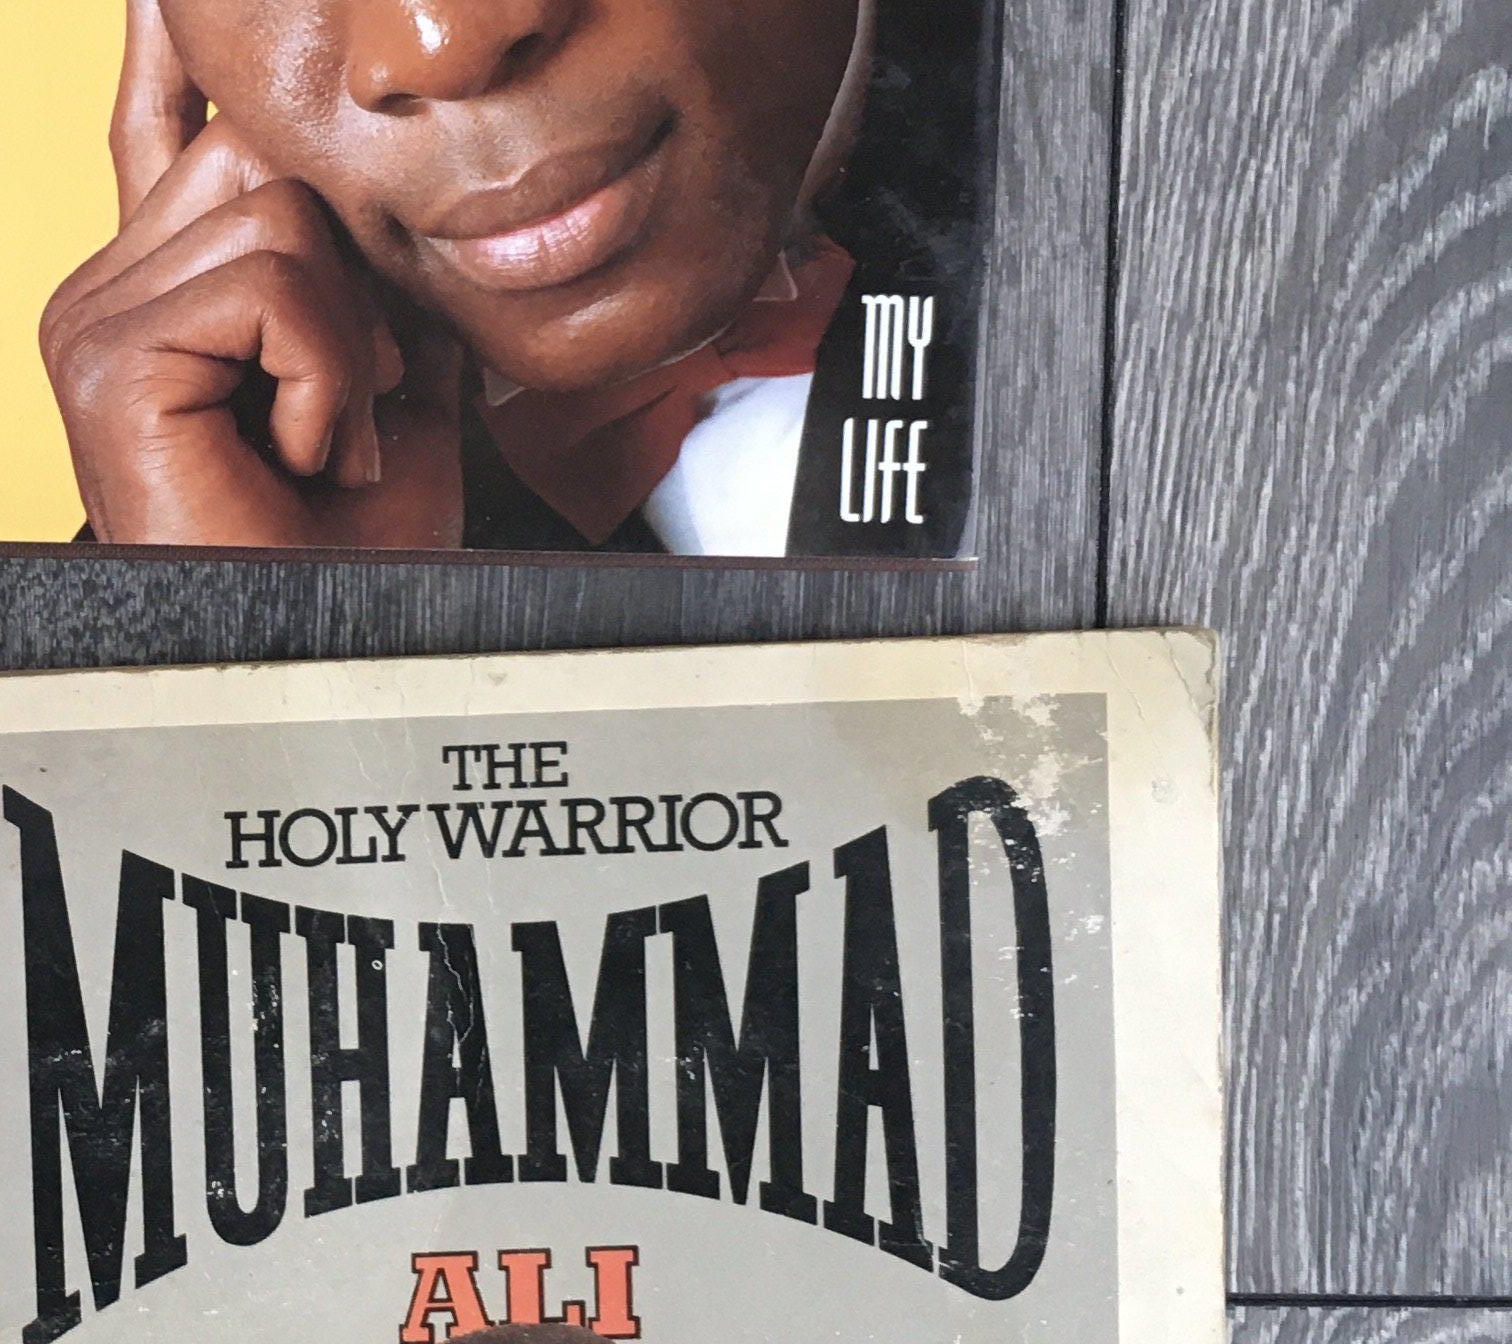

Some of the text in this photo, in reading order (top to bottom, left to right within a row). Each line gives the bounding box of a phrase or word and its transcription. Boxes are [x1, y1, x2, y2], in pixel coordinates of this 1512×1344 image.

[861, 294, 934, 400] MY
[840, 417, 928, 524] LIFE
[442, 740, 569, 791] THE
[224, 791, 789, 869] HOLY WARRIOR
